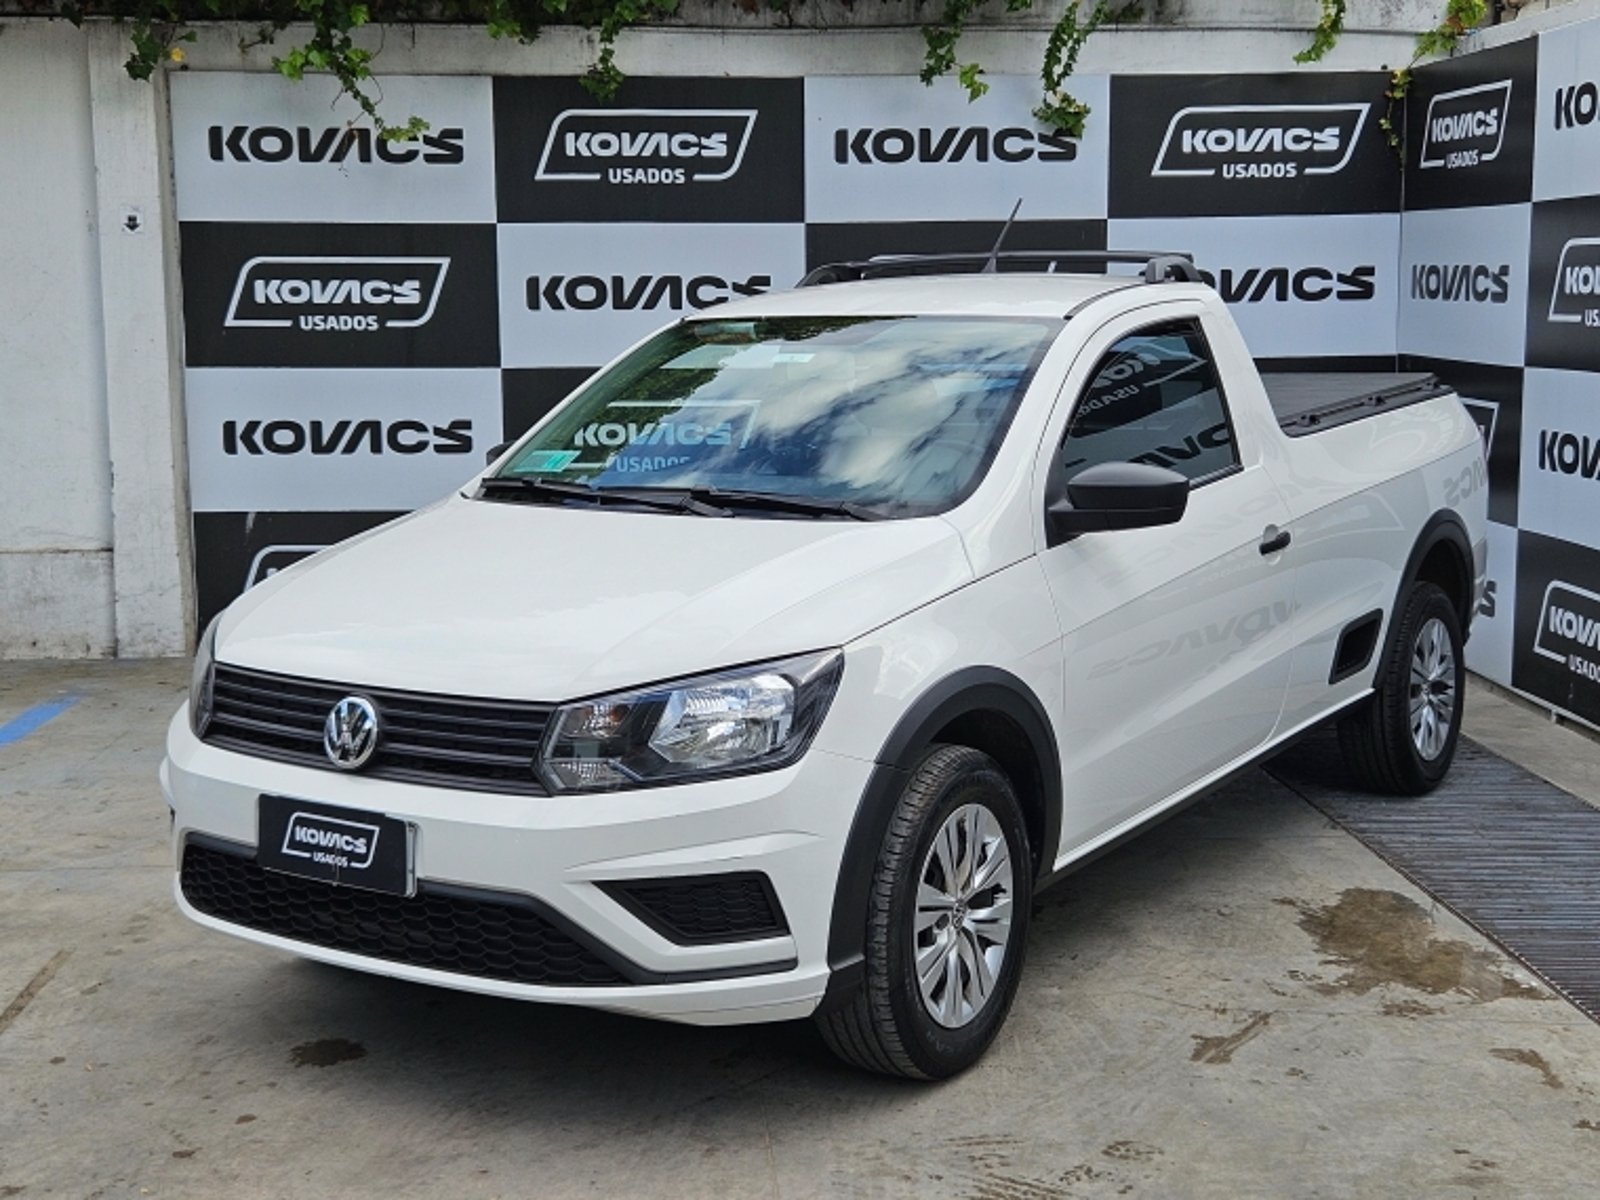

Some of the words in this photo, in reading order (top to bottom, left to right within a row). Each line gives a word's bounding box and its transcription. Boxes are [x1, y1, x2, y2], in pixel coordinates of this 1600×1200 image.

[1432, 108, 1498, 143] KOVACS
[208, 126, 464, 164] KOVACS
[565, 132, 727, 157] KOVACS
[835, 127, 1077, 164] KOVACS
[1182, 127, 1340, 153] KOVACS
[1222, 162, 1297, 178] USADOS
[1446, 150, 1479, 168] USADOS
[608, 168, 685, 184] USADOS
[254, 280, 421, 304] KOVACS
[1198, 265, 1375, 303] VACS
[1412, 264, 1510, 303] KOVACS
[300, 315, 379, 331] USADOS
[223, 420, 473, 454] KOVACS
[573, 422, 732, 447] KOVACS
[1539, 429, 1600, 480] KOV
[1549, 606, 1600, 651] KOVA
[295, 826, 368, 853] KOVACS
[313, 852, 348, 867] USADOS
